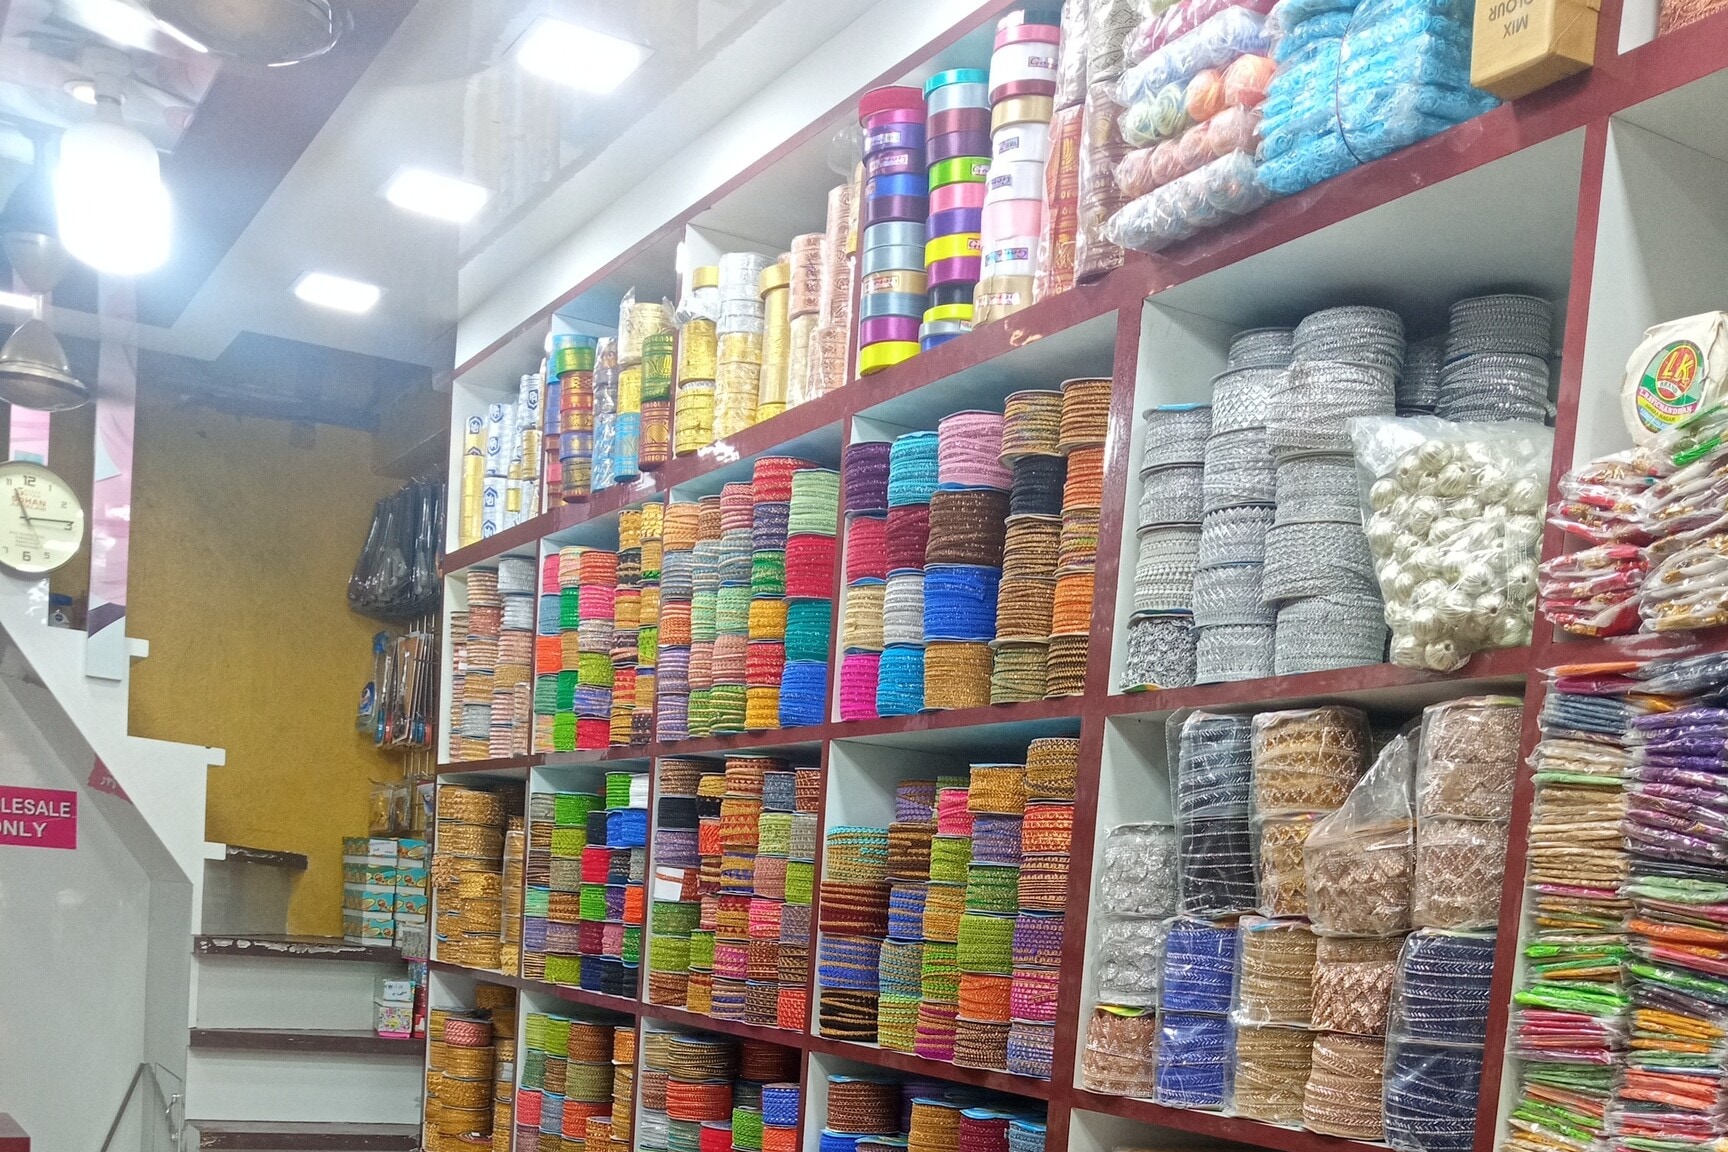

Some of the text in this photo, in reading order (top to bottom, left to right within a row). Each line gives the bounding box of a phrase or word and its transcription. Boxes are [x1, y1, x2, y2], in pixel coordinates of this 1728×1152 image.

[1503, 14, 1528, 39] MIX
[23, 475, 36, 487] 12
[61, 501, 68, 509] 2
[64, 522, 73, 531] 3
[22, 551, 32, 562] 6
[1, 797, 71, 818] LESALE
[0, 819, 47, 838] NLY
